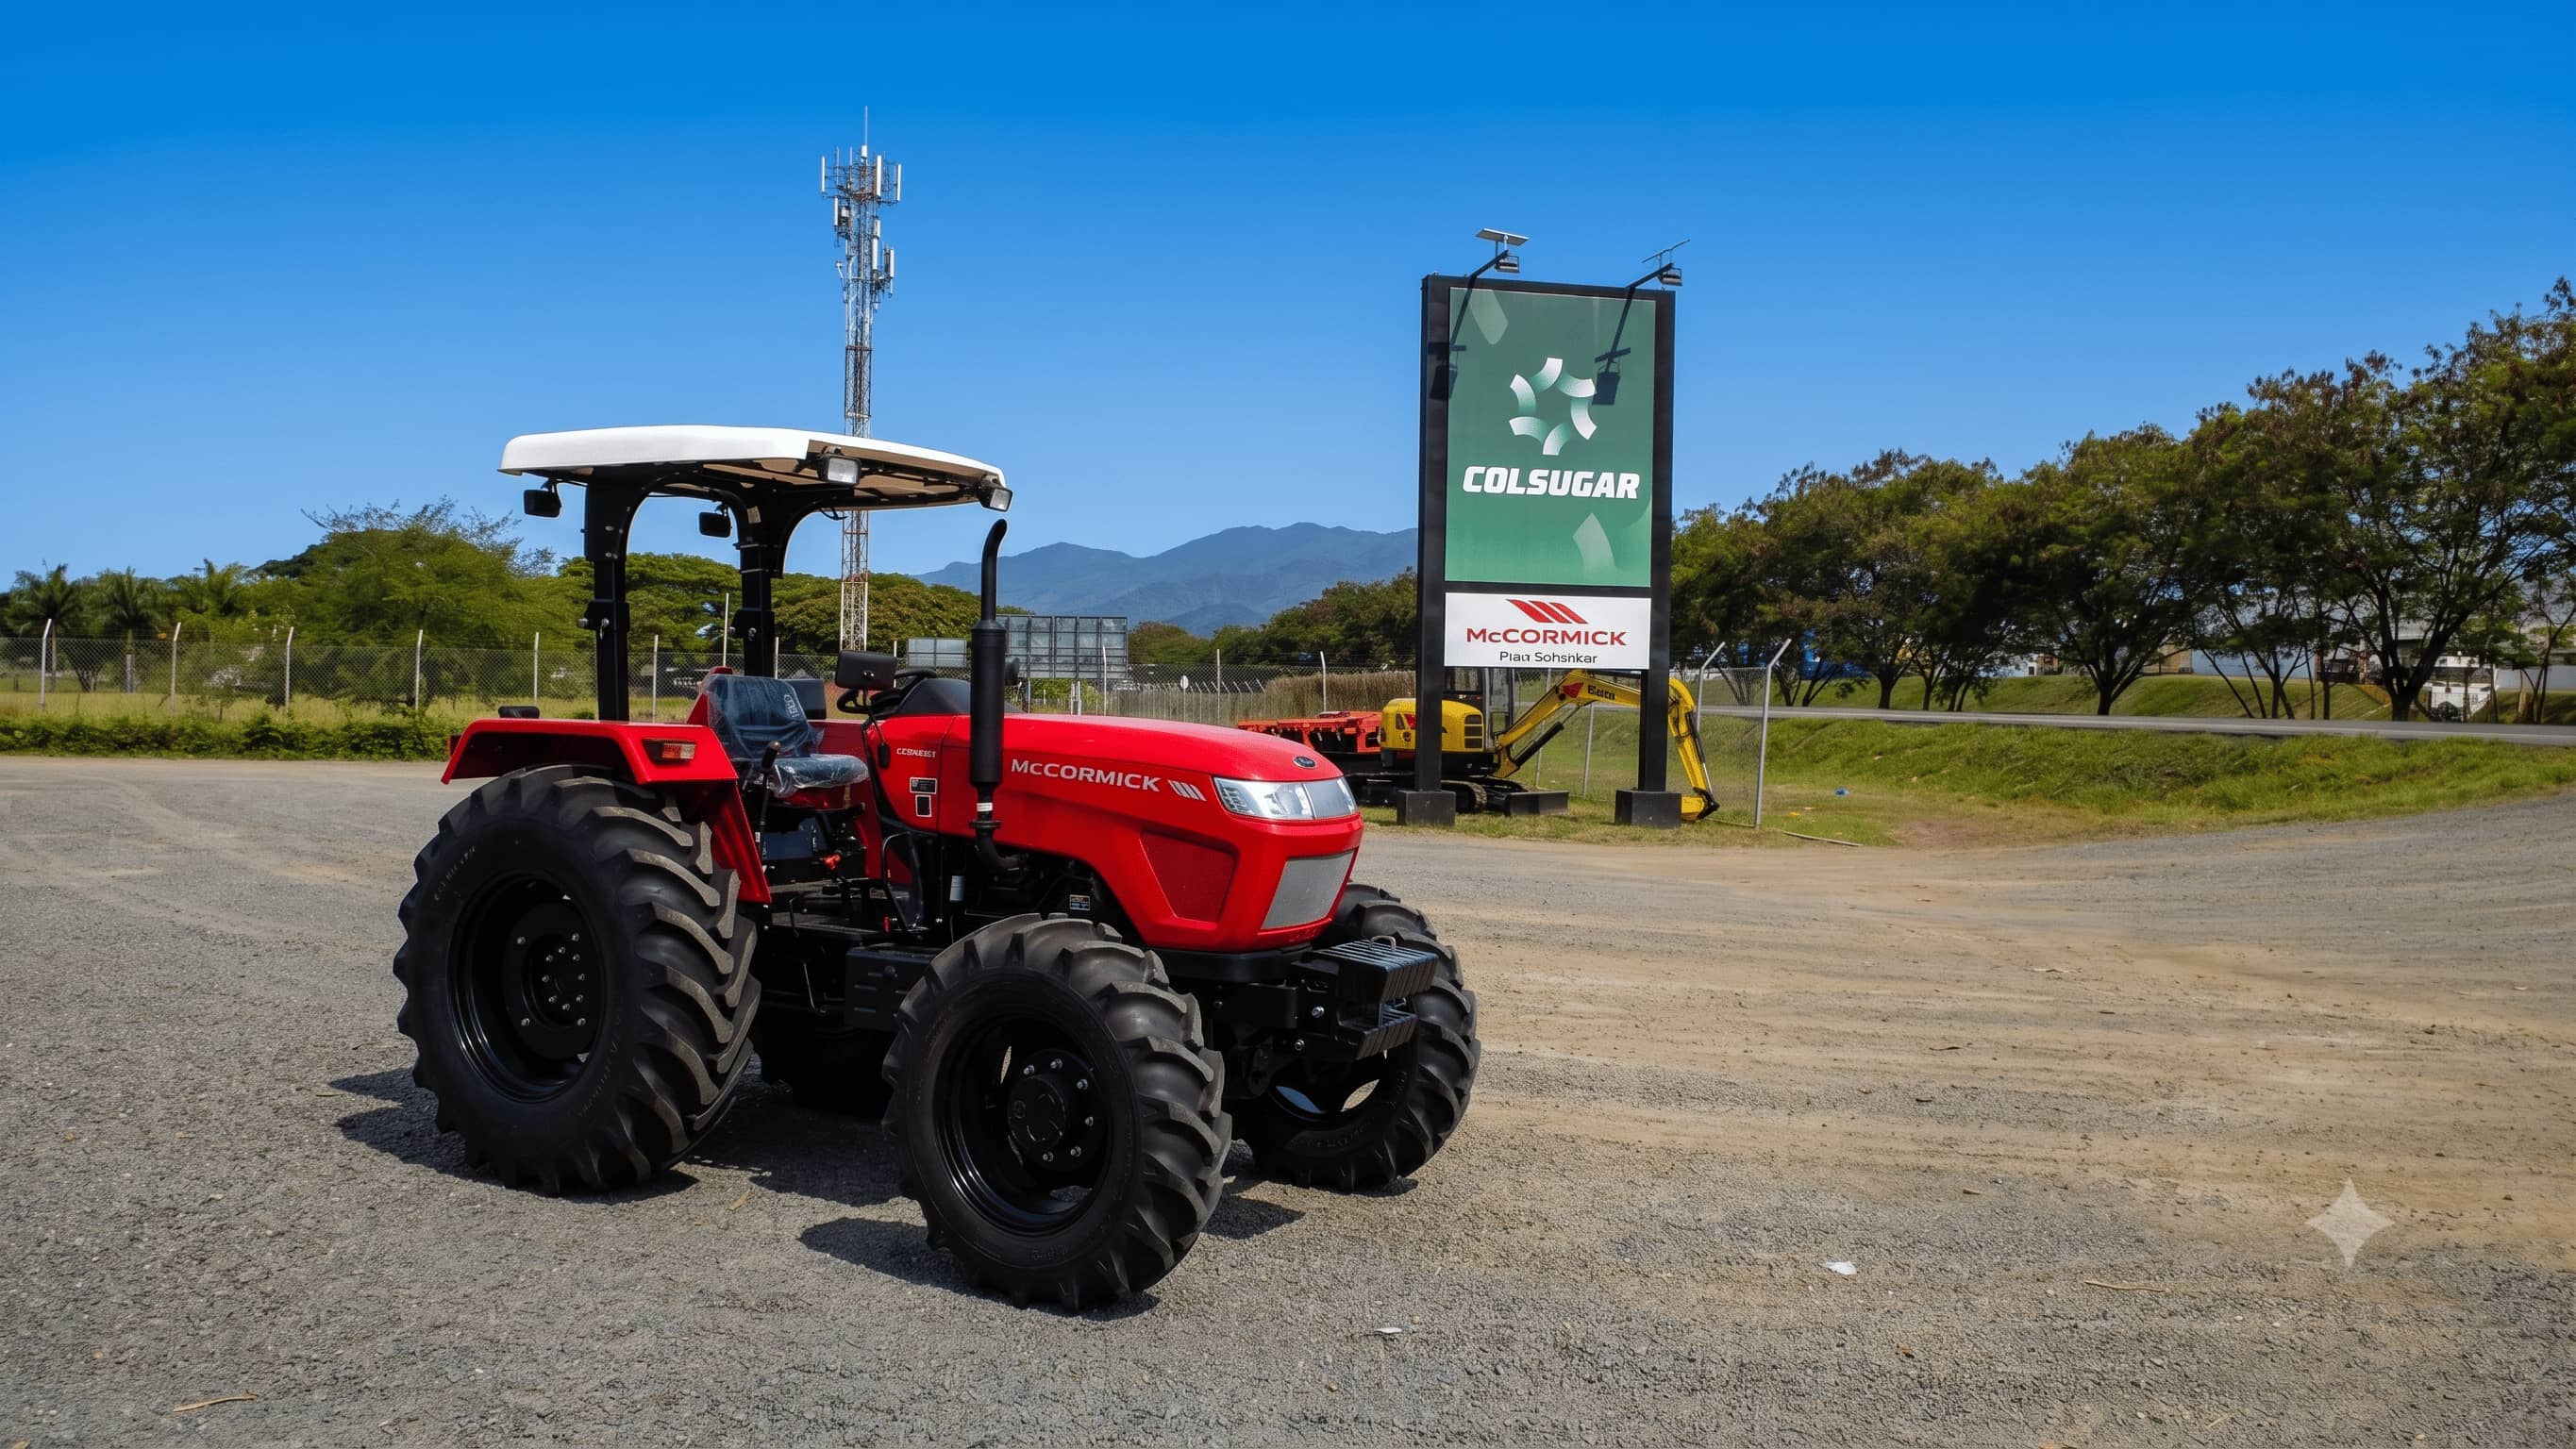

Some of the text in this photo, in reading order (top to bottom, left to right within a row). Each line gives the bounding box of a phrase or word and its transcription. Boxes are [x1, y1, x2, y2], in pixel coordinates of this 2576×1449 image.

[1463, 466, 1640, 499] COLSUGAR
[1466, 627, 1628, 646] McCORMICK
[1011, 758, 1162, 792] McCORMICK
